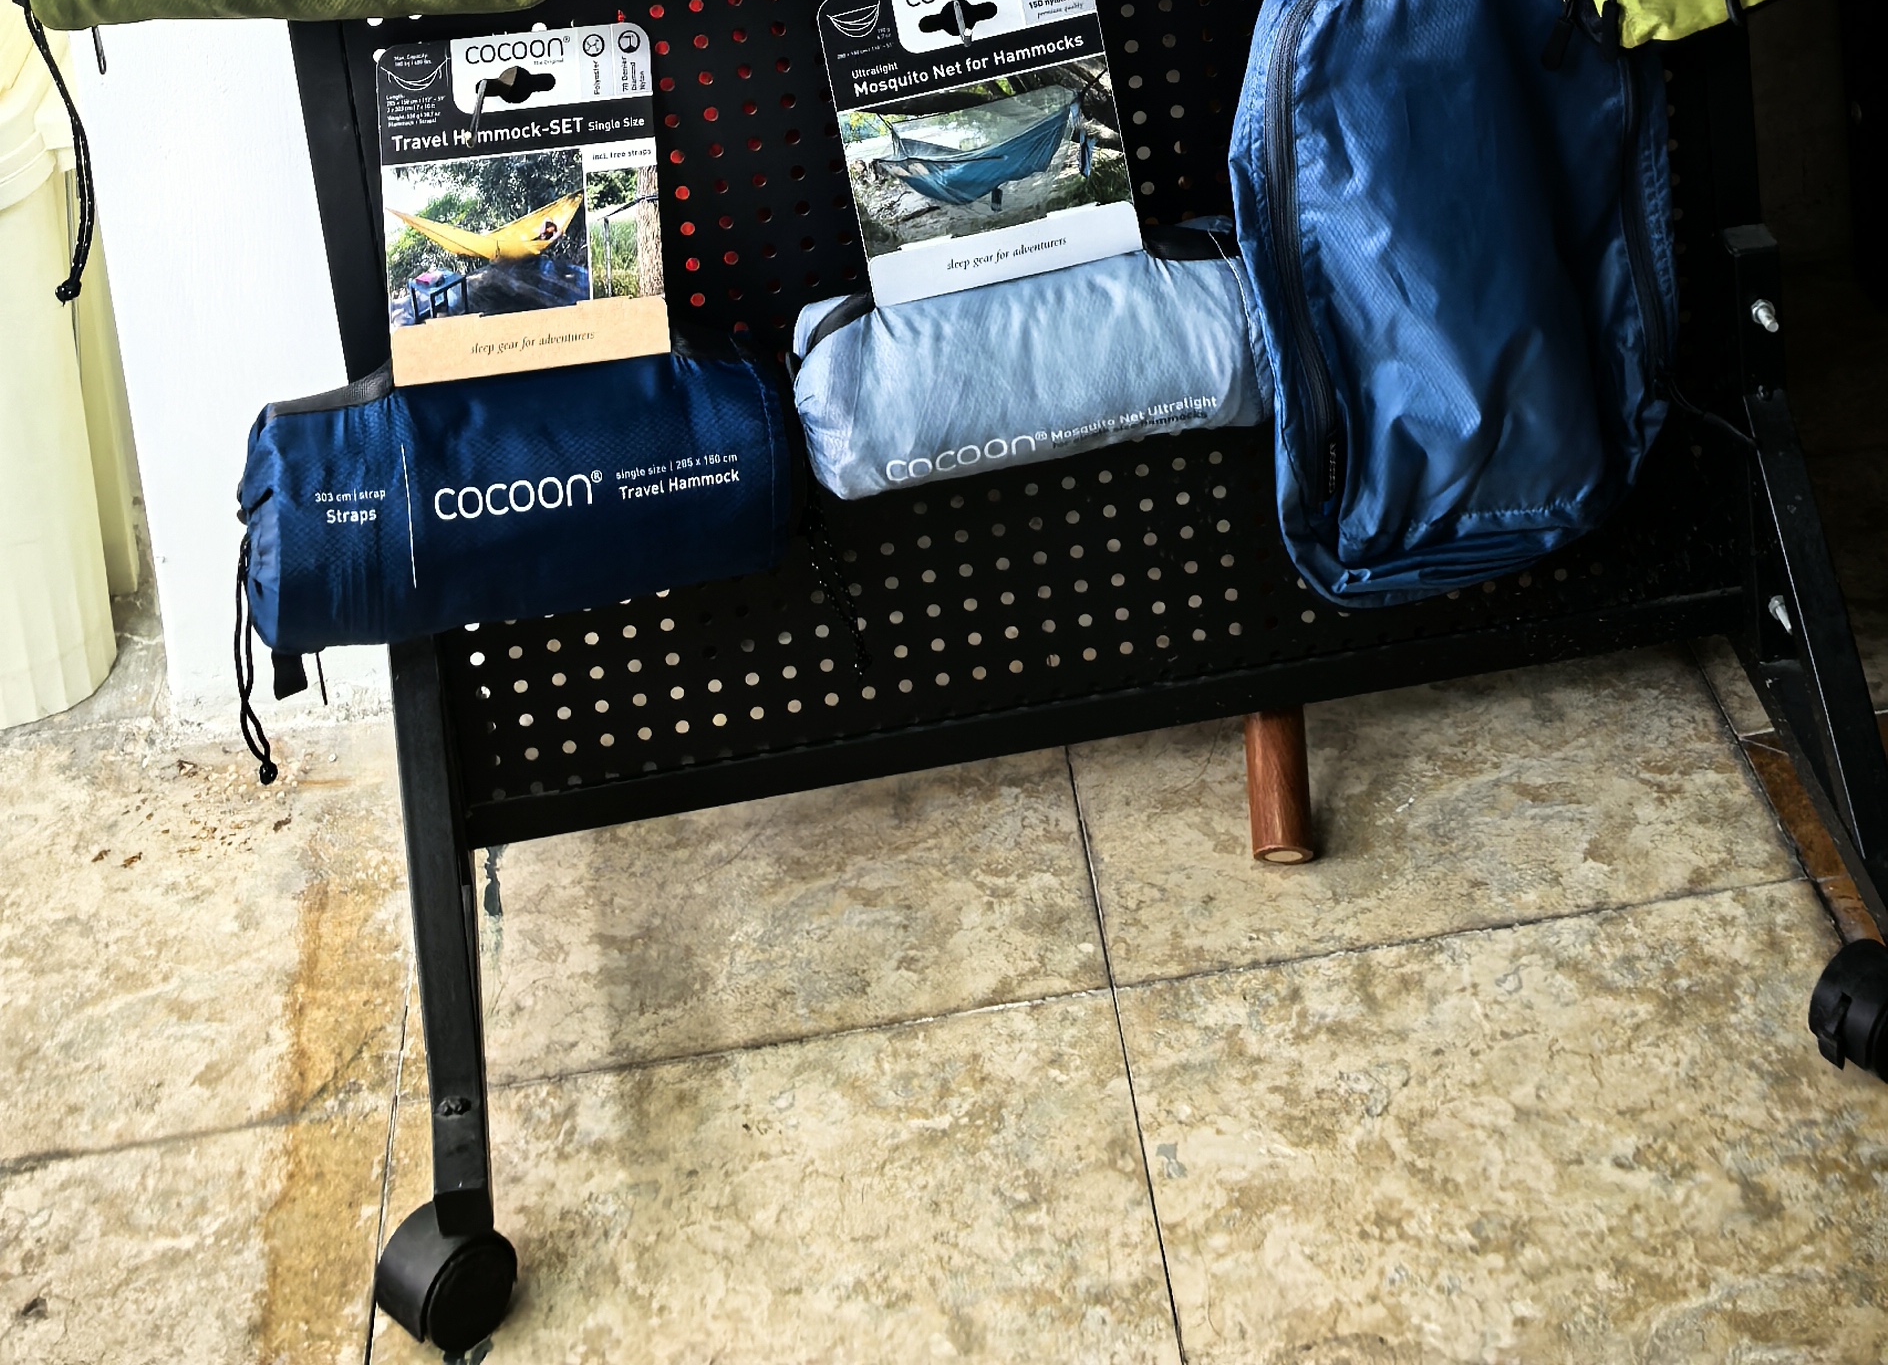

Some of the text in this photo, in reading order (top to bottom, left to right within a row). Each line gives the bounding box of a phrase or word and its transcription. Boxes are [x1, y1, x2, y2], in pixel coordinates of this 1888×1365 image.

[851, 62, 898, 80] Ultralight
[853, 33, 1084, 98] Mosquito Net for Hammocks
[392, 116, 645, 152] Travel Hmmock-SET Single Size
[947, 237, 1067, 270] sleep gear for adventurers
[1051, 418, 1115, 442] Mosquito
[1120, 411, 1145, 424] Net
[1148, 396, 1217, 416] Ultralight
[314, 492, 334, 503] 303
[619, 469, 740, 501] Travel Hammock
[325, 507, 377, 526] Straps
